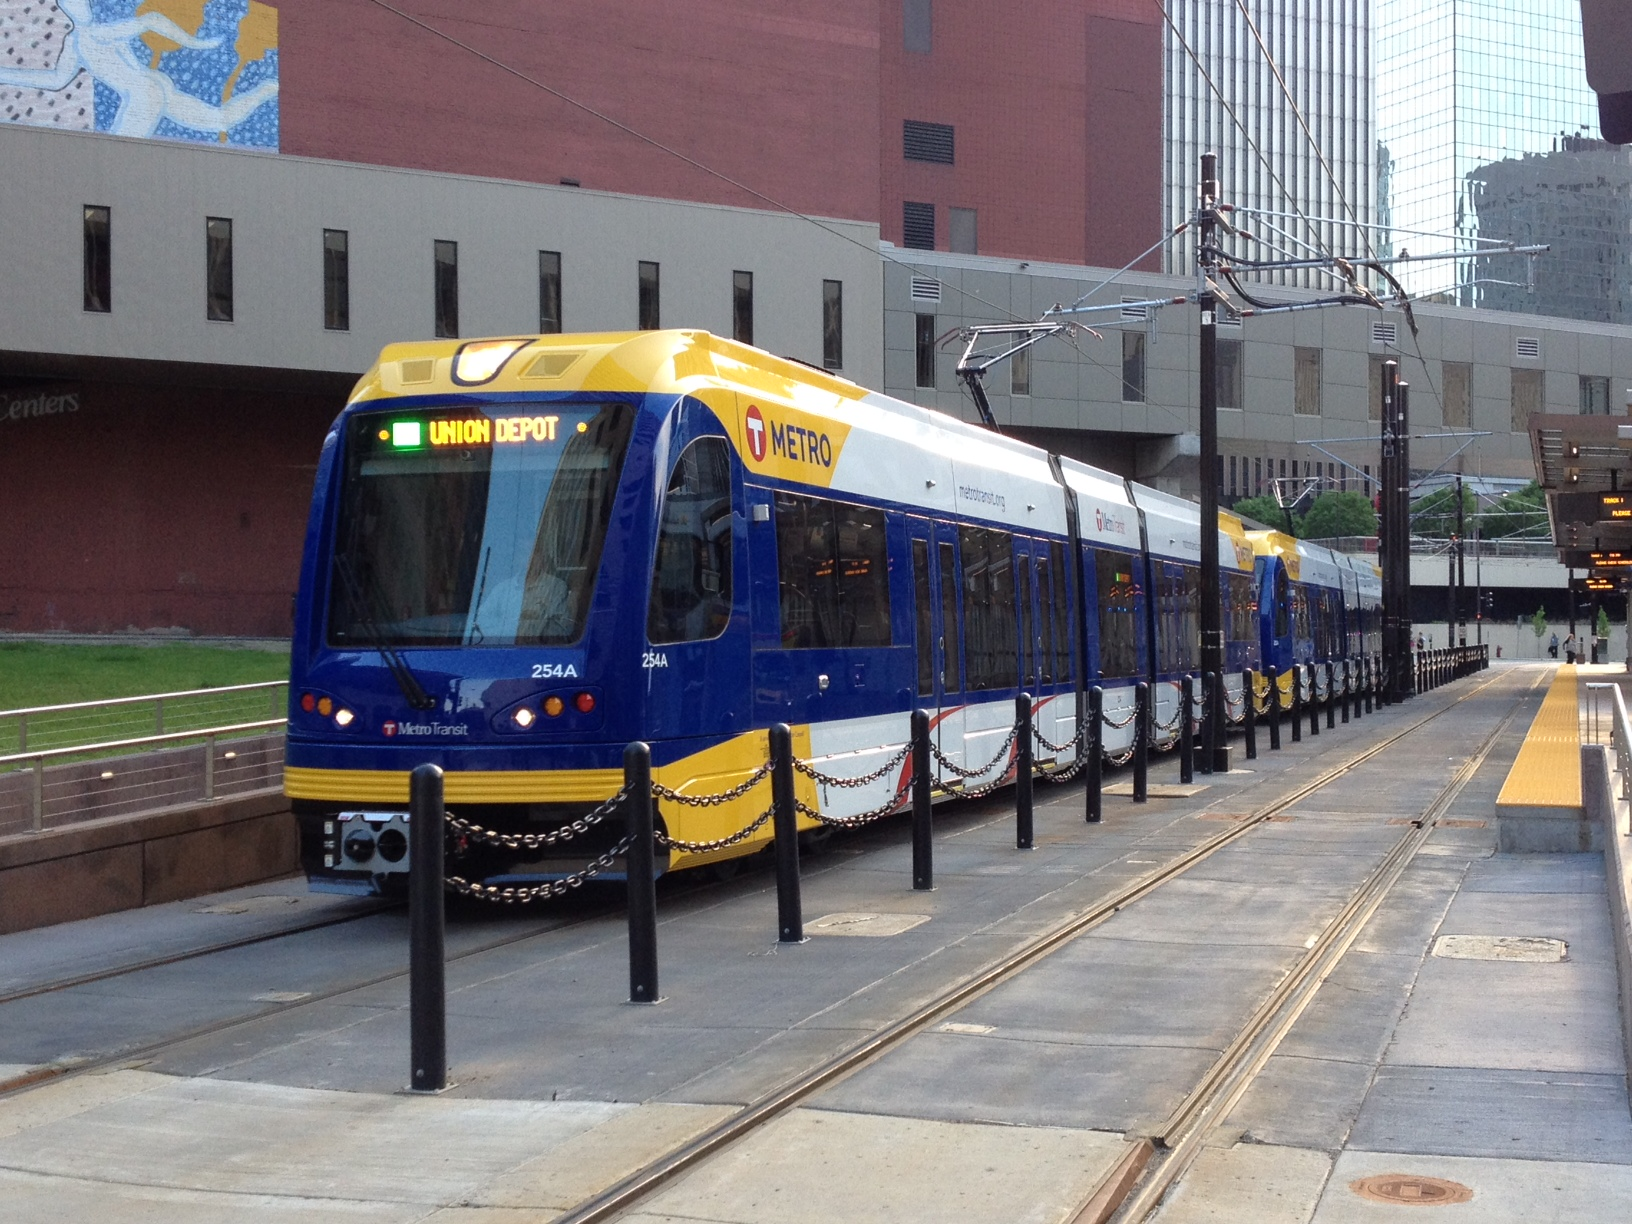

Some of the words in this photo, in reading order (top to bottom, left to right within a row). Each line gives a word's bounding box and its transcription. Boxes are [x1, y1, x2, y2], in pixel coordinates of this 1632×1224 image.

[429, 419, 491, 445] UNION
[494, 416, 560, 443] DEPOT
[770, 419, 831, 468] METRO
[959, 484, 1006, 513] metrotransit.org
[531, 663, 578, 679] 254A
[641, 652, 669, 668] 254A
